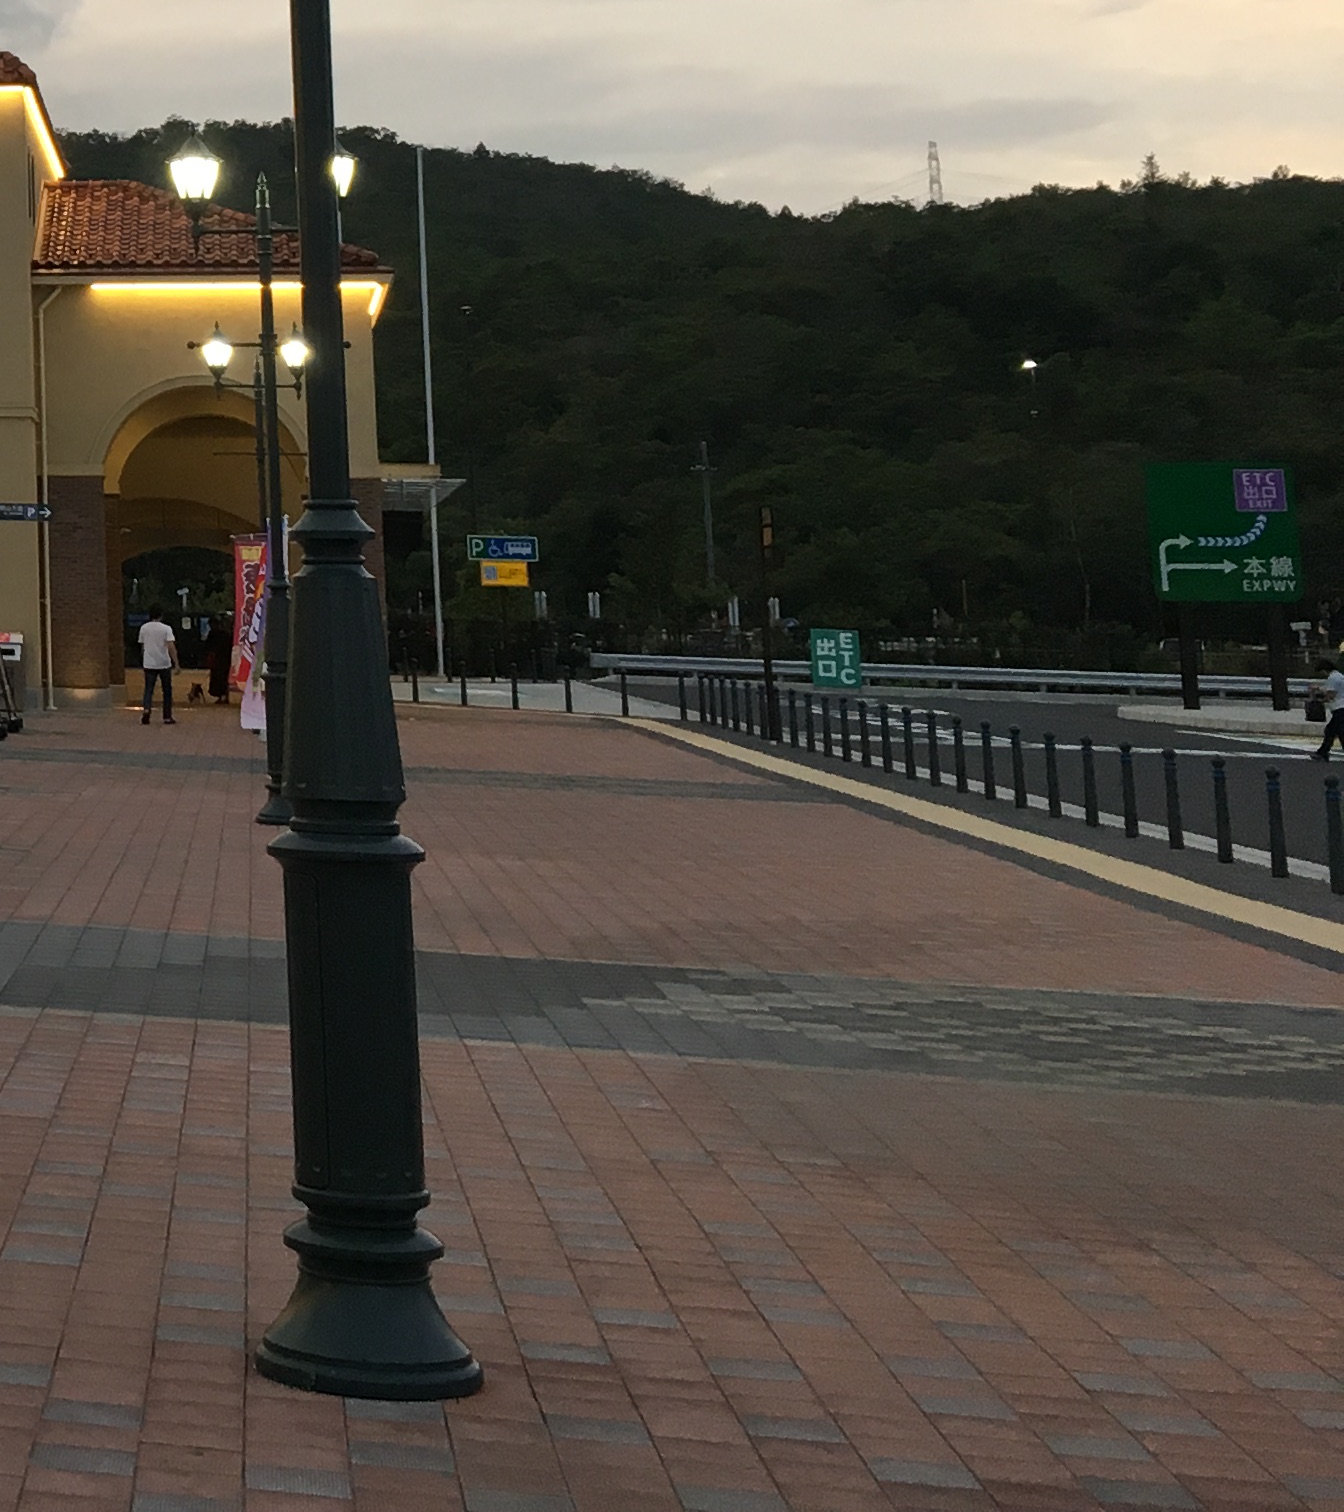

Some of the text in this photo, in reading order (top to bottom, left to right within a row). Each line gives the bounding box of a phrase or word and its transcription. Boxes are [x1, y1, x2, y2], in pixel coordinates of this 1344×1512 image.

[1241, 472, 1276, 486] ETC
[1244, 486, 1277, 499] 出口
[1249, 499, 1273, 508] EXIT
[472, 538, 484, 557] P
[1243, 556, 1295, 577] 本線
[1242, 579, 1297, 592] EXPWY
[816, 637, 837, 677] 出口
[839, 632, 857, 685] ETC
